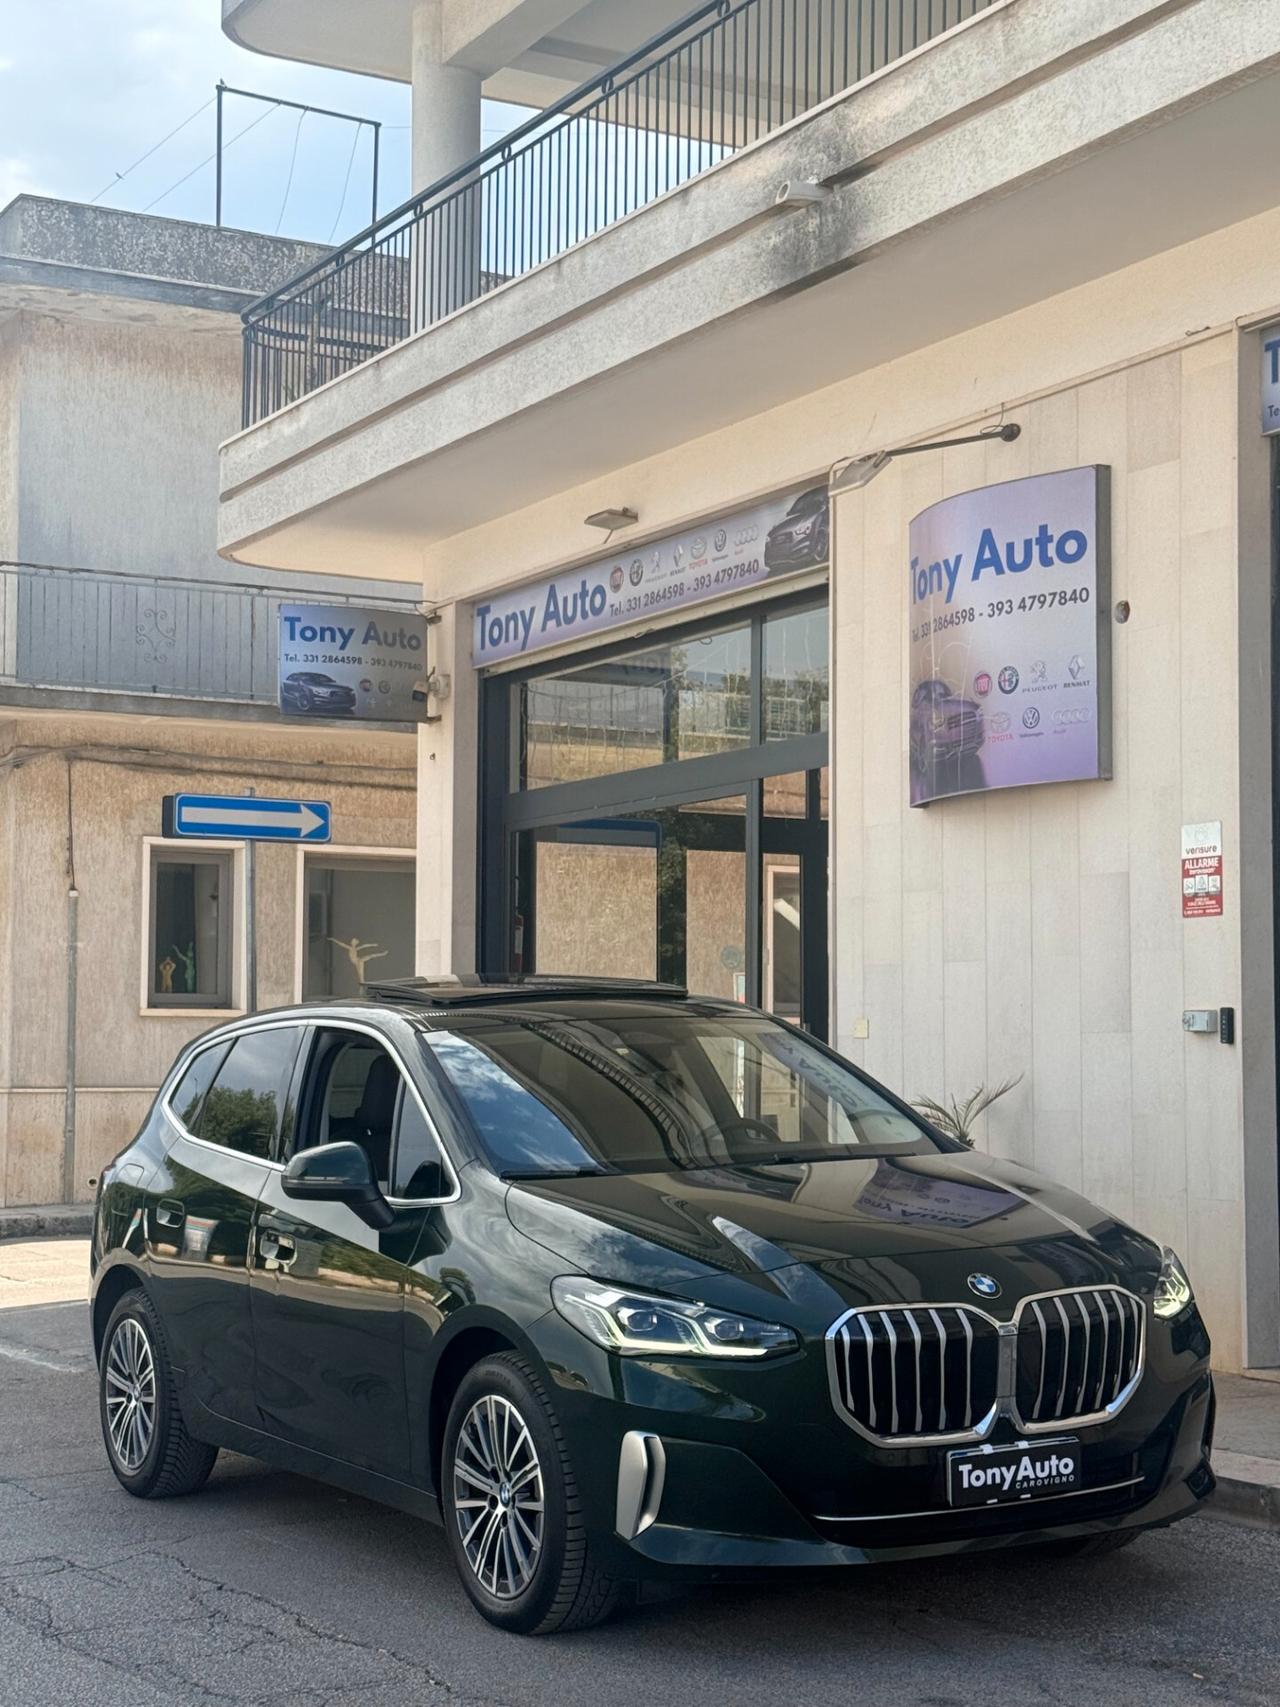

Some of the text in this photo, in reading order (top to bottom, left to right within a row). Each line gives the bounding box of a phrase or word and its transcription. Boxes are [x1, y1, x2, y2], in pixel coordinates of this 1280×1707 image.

[911, 524, 1088, 605] Tony Auto
[610, 600, 624, 617] Tel.
[626, 596, 641, 612] 331
[643, 582, 685, 608] 2864598
[693, 574, 711, 593] 393
[714, 559, 759, 584] 4797840
[476, 580, 607, 651] Tony Auto
[933, 607, 975, 633] 2864598
[987, 600, 1013, 618] 393
[1017, 587, 1089, 613] 4797840
[284, 616, 421, 651] Tony Auto
[284, 653, 300, 663] Tel.
[303, 654, 319, 664] 331
[322, 654, 363, 665] 2864598
[1184, 857, 1219, 870] ALLARME
[1016, 1474, 1075, 1489] CAROVIGNO
